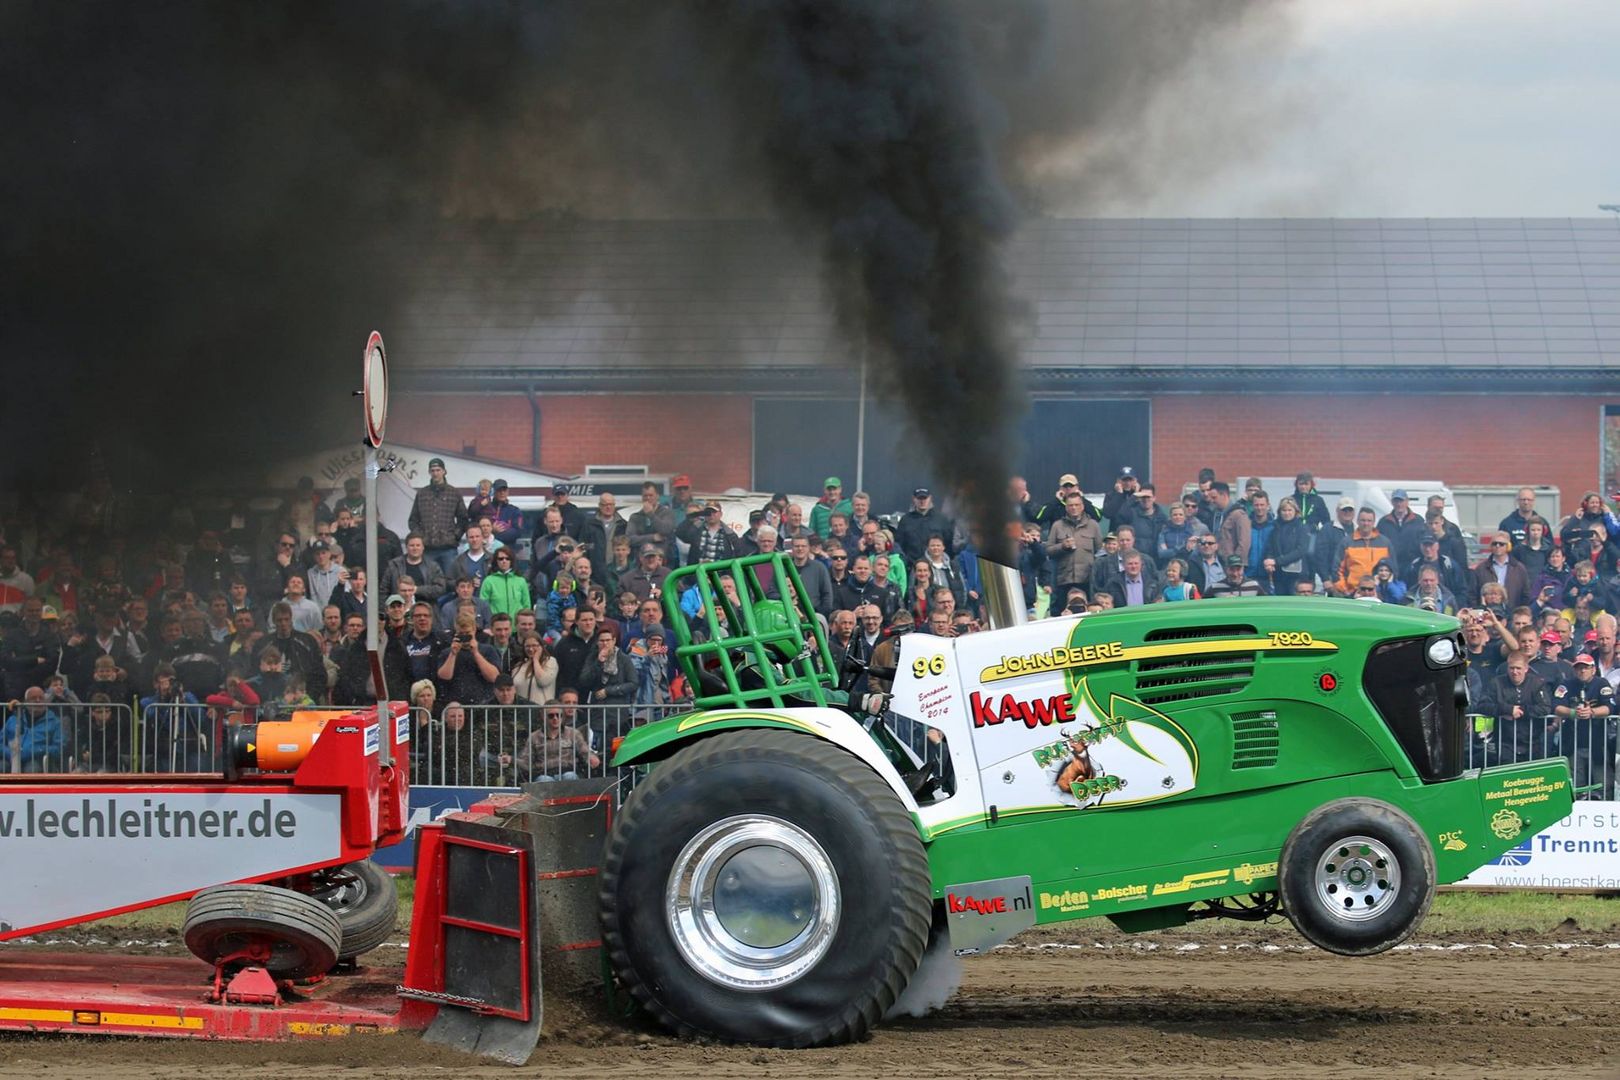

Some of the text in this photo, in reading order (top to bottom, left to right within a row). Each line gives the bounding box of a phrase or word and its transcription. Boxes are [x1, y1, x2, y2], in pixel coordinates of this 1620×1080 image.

[1267, 631, 1313, 647] 7920
[912, 653, 946, 680] 96
[996, 641, 1124, 675] JOHN DEERE
[1069, 774, 1123, 801] DEER
